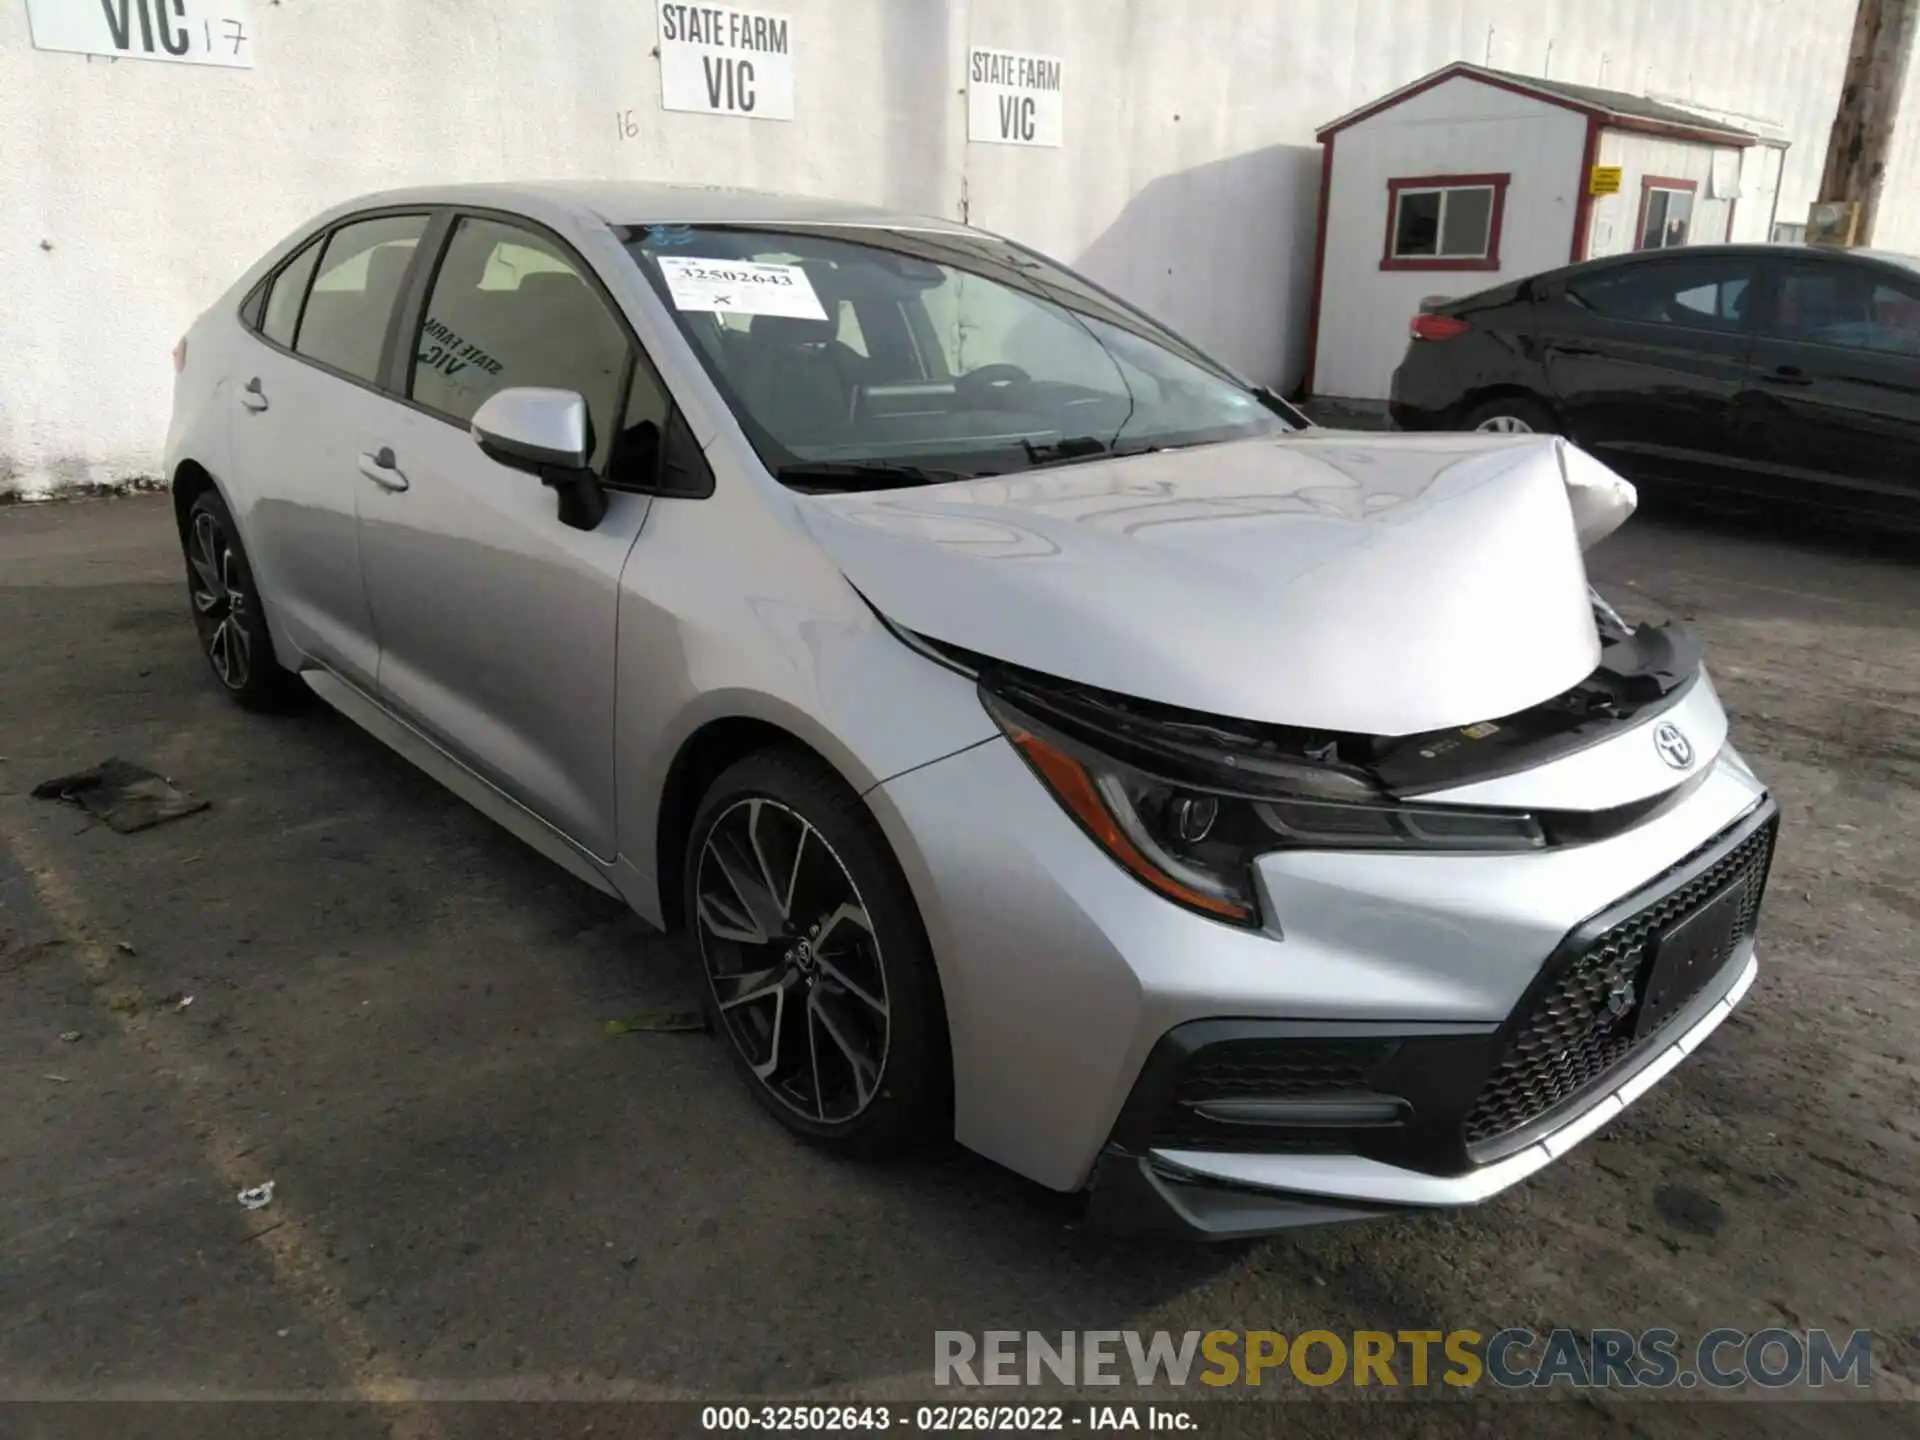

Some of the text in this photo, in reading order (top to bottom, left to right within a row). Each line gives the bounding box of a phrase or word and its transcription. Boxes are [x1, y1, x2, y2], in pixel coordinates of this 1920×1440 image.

[102, 0, 189, 56] VIC
[204, 18, 247, 54] 17
[662, 3, 788, 54] STATE FARM
[702, 55, 755, 111] VIC
[972, 51, 1060, 91] STATE FARM
[617, 110, 639, 141] 16
[999, 94, 1034, 141] VIC
[679, 267, 794, 286] 32502643
